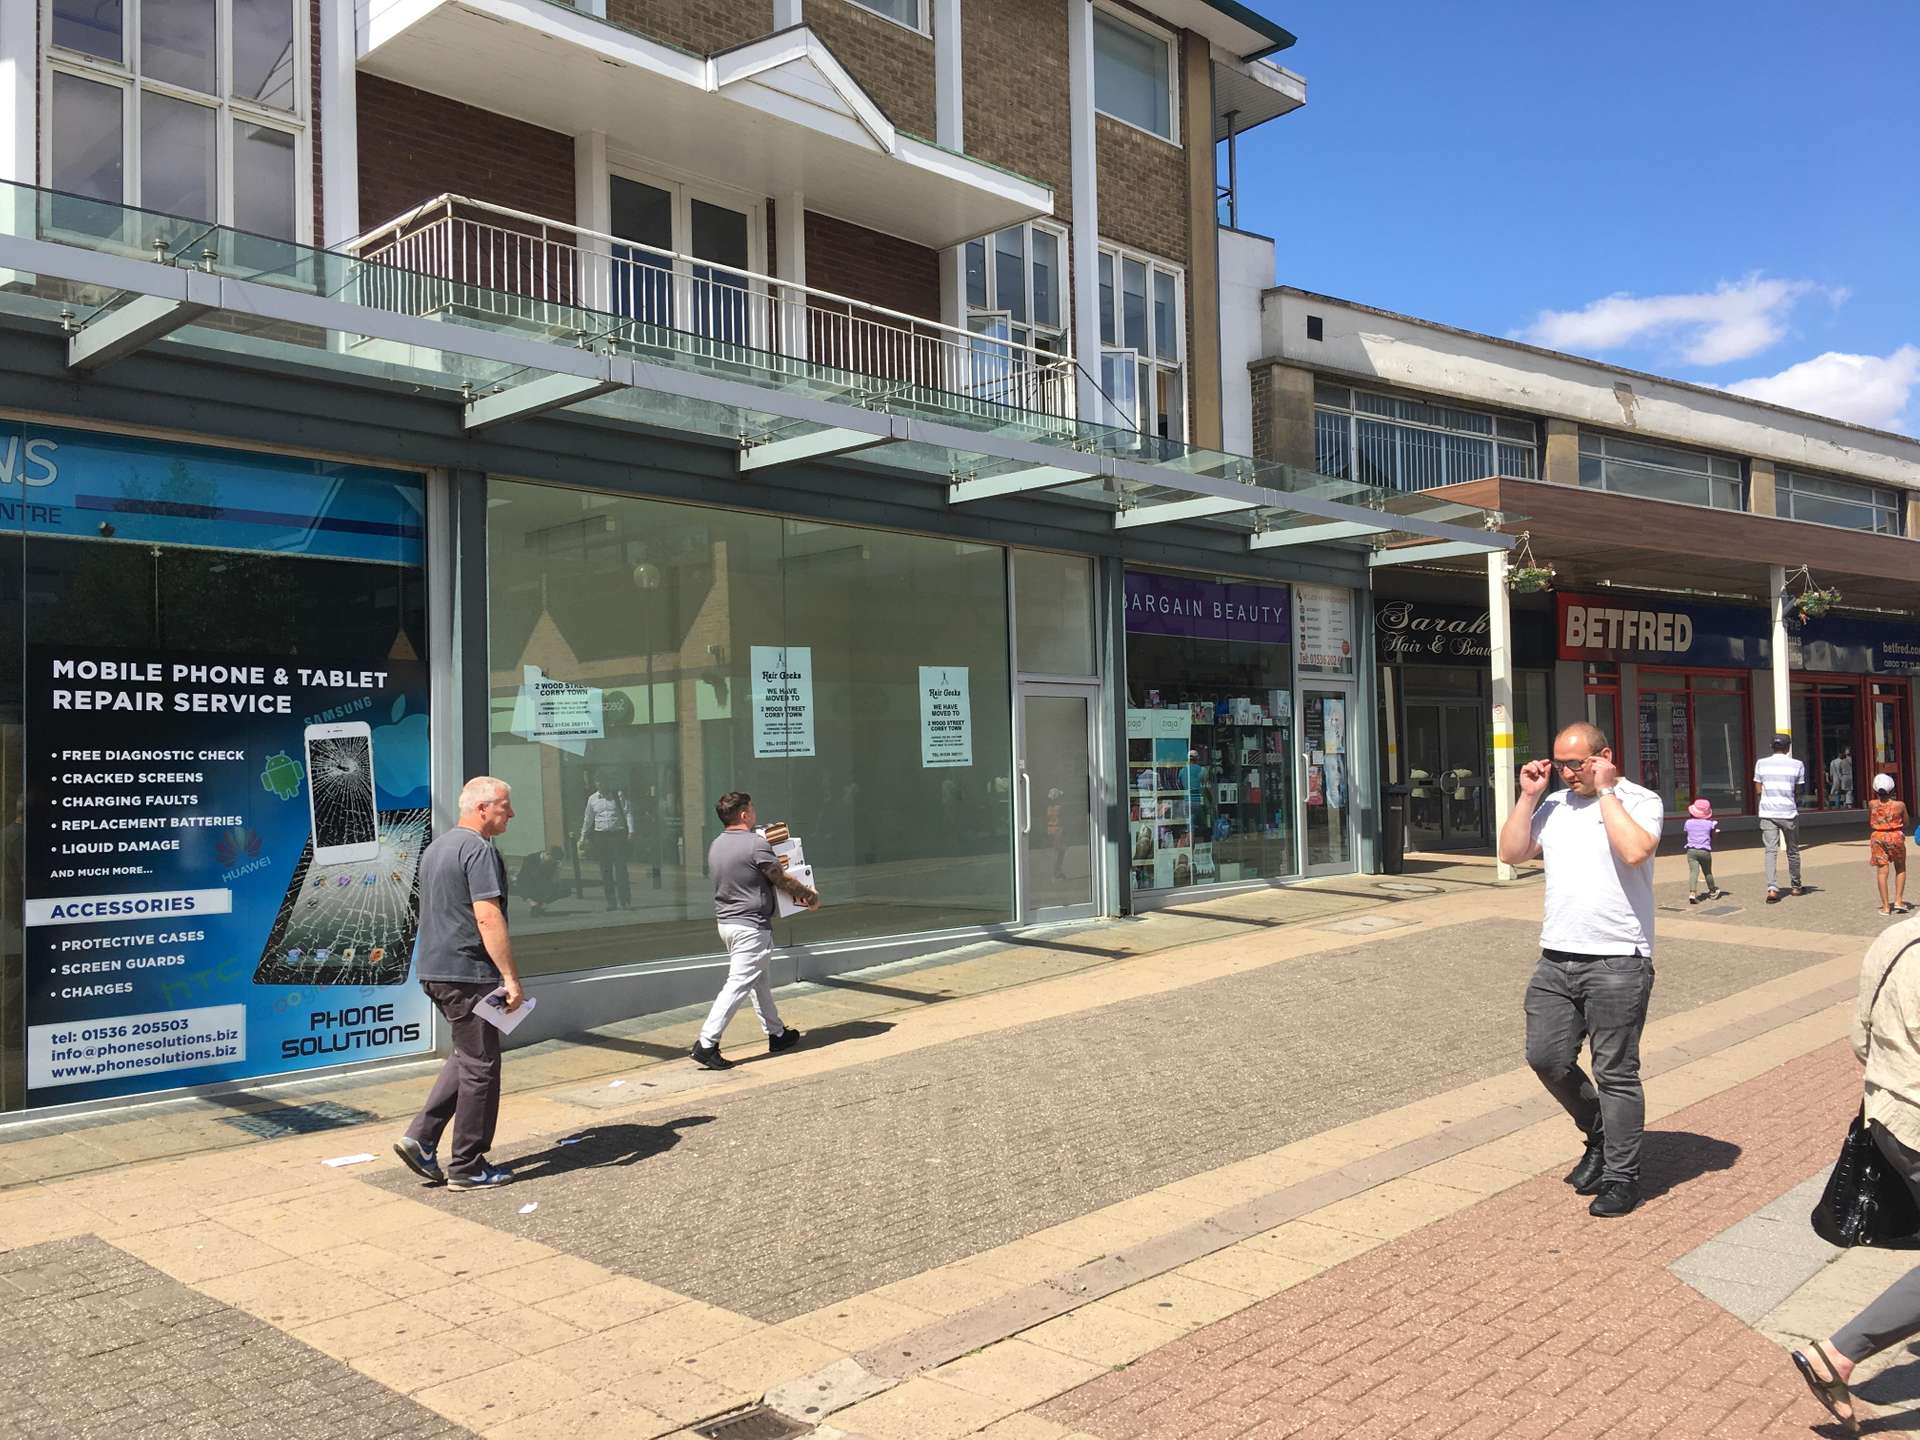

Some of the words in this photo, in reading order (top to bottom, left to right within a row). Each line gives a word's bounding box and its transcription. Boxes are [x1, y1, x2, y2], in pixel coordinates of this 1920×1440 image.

[1213, 601, 1283, 624] BEAUTY
[1565, 606, 1694, 652] BETFRED
[1382, 632, 1422, 654] Hair
[1428, 634, 1446, 654] &
[1882, 642, 1920, 654] betfred.co
[53, 660, 163, 682] MOBILE
[173, 664, 265, 684] PHONE
[273, 668, 289, 685] &
[298, 669, 388, 688] TABLET
[53, 690, 164, 712] REPAIR
[174, 695, 292, 714] SERVICE
[303, 696, 373, 725] SAMSUNG
[62, 750, 101, 761] FREE
[105, 750, 195, 761] DIAGNOSTIC
[198, 749, 245, 761] CHECK
[62, 772, 134, 784] CRACKED
[138, 772, 203, 783] SCREENS
[62, 795, 142, 807] CHARGING
[146, 794, 198, 806] FAULTS
[61, 817, 167, 831] REPLACEMENT
[170, 815, 242, 828] BATTERIES
[62, 841, 115, 854] LIQUID
[118, 840, 180, 852] DAMAGE
[51, 869, 75, 878] AND
[78, 867, 110, 876] MUCH
[112, 865, 153, 875] MORE...
[221, 856, 272, 882] HUAWEI
[51, 896, 195, 920] ACCESSORIES
[61, 933, 155, 952] PROTECTIVE
[159, 930, 205, 944] CASES
[61, 959, 122, 975] SCREEN
[126, 954, 185, 969] GUARDS
[61, 982, 133, 999] CHARGES
[310, 1003, 394, 1031] PHONE
[51, 1031, 77, 1045] tel:
[81, 1024, 129, 1042] 01536
[132, 1018, 190, 1037] 205503
[281, 1023, 420, 1060] SOLUTIONS
[51, 1028, 238, 1062] info@phonesolutions.biz
[51, 1043, 237, 1079] www.phonesolutions.biz
